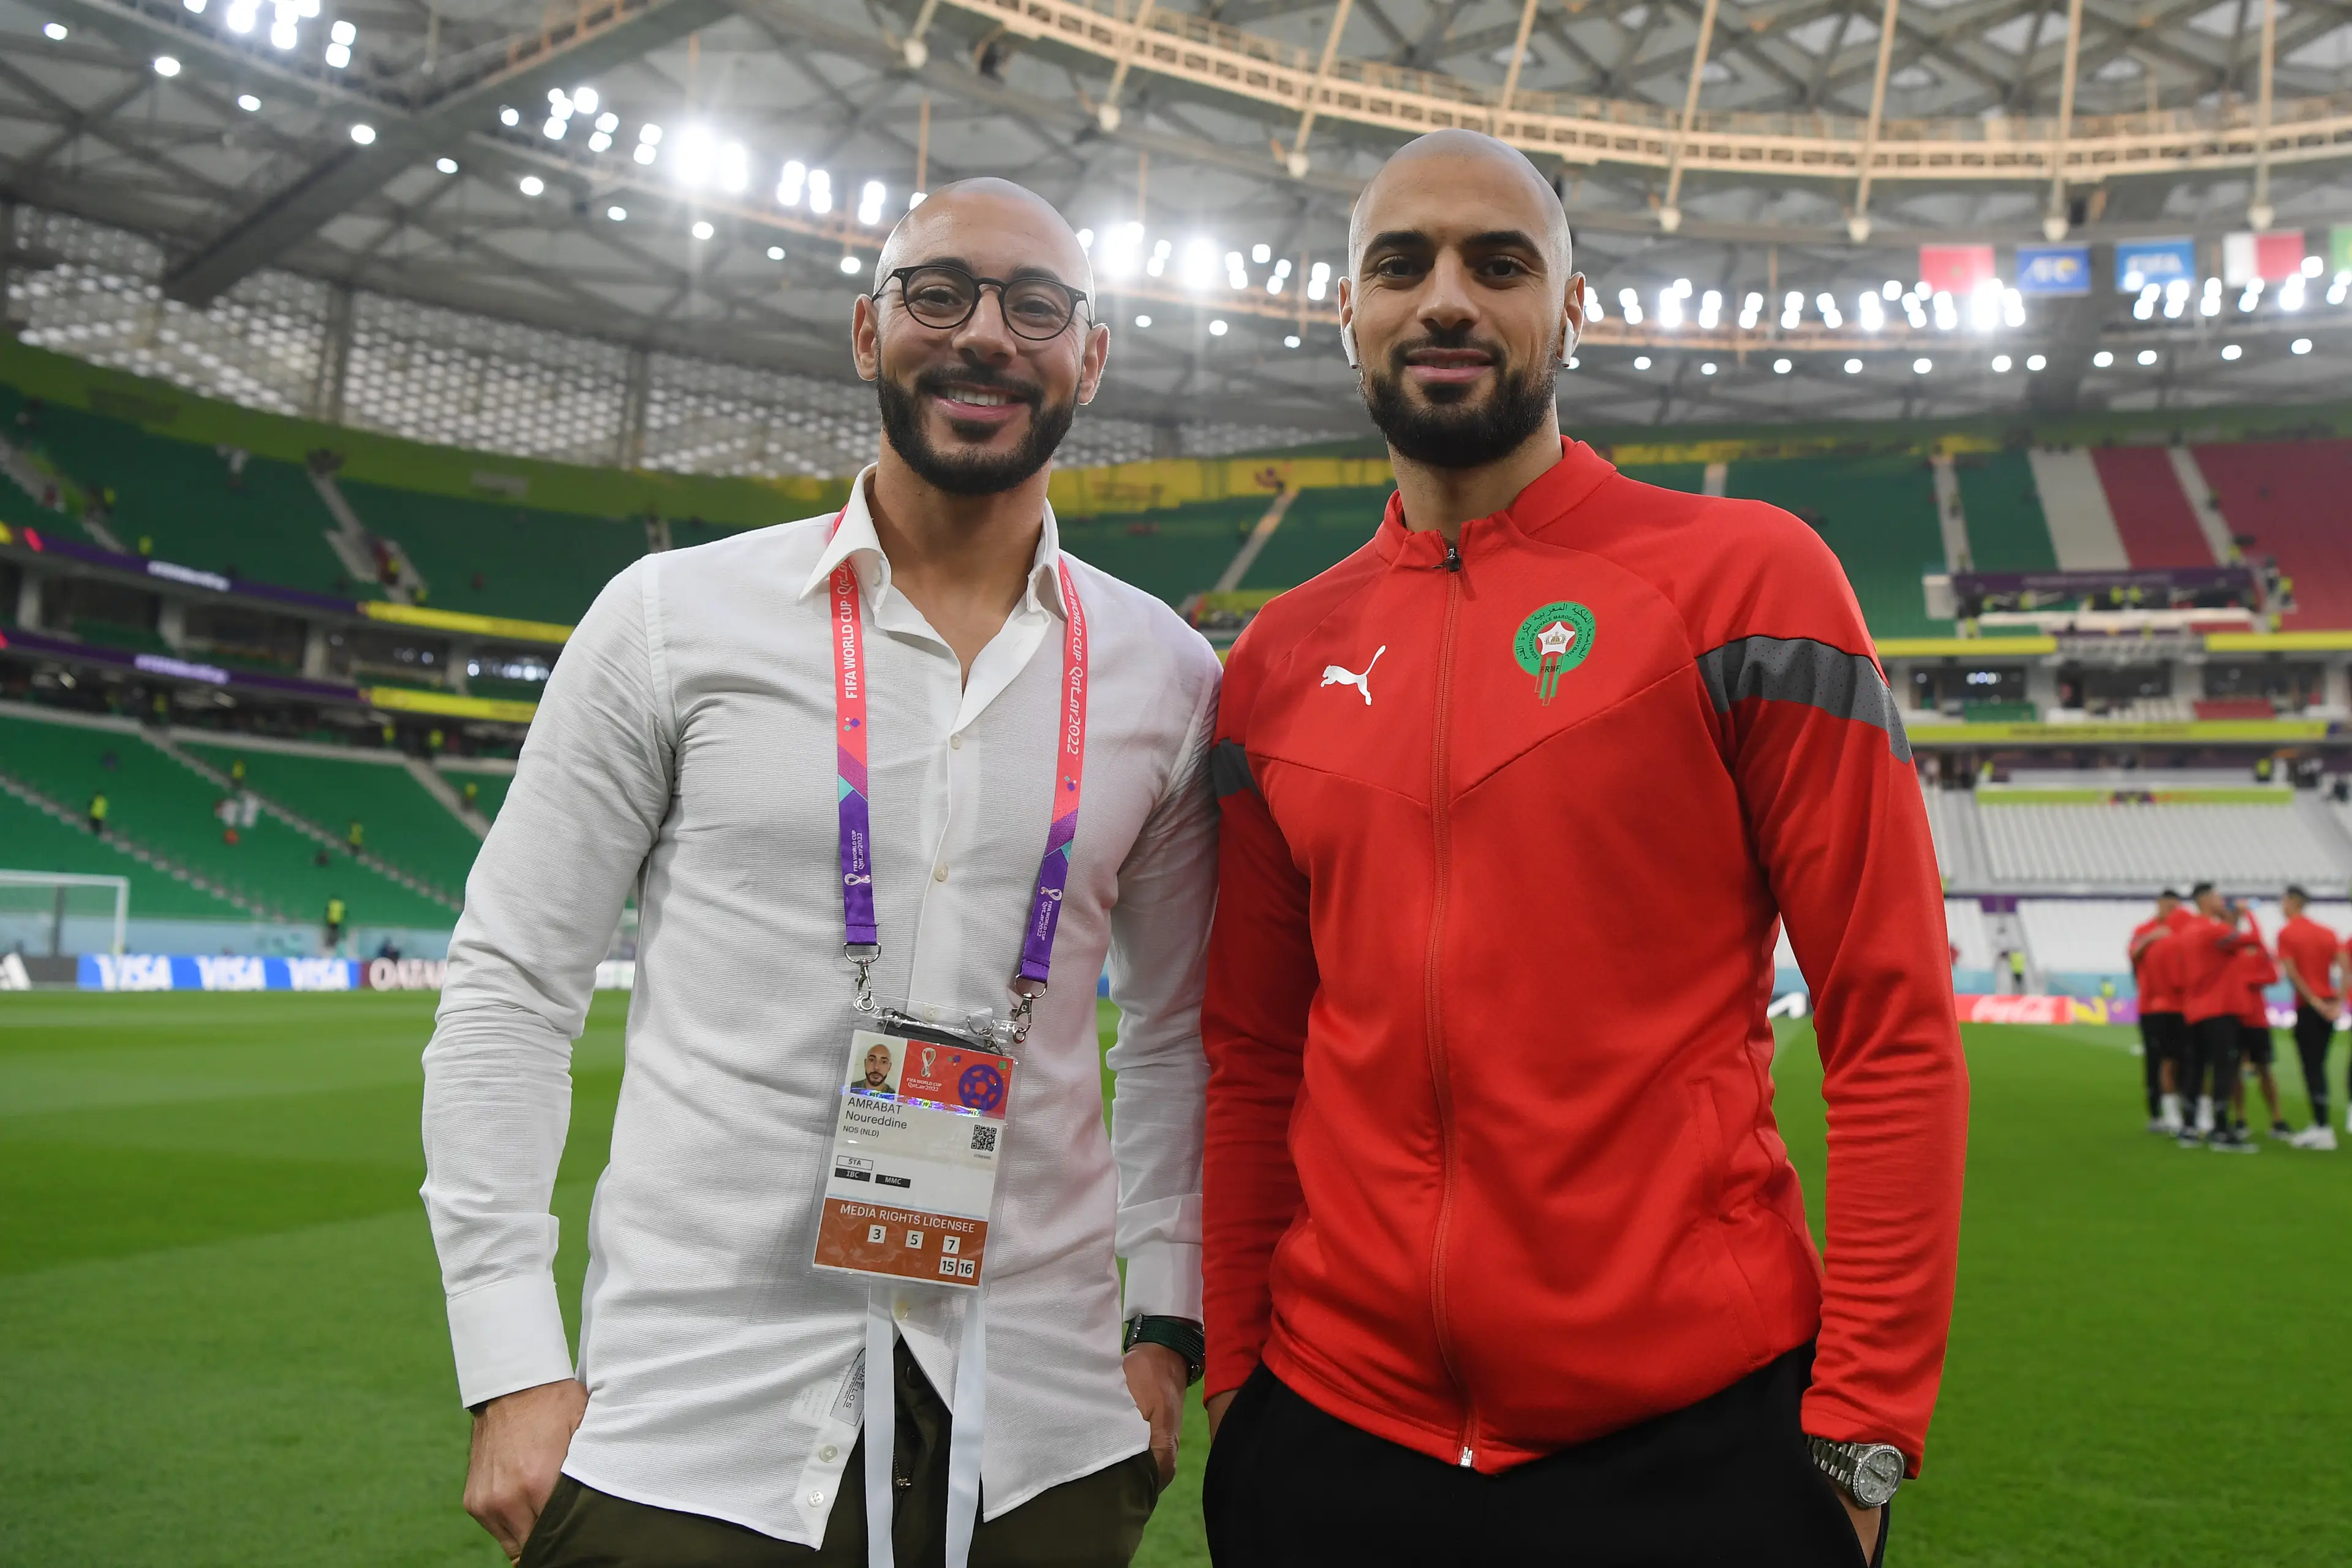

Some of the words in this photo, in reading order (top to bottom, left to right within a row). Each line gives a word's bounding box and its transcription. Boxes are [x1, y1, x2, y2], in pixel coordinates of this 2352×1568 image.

[1064, 574, 1074, 597] FIFA
[840, 600, 853, 623] CUP
[1069, 596, 1082, 636] WORLD
[1531, 603, 1567, 620] المغربية
[1553, 615, 1580, 627] MAROCAINE
[1572, 605, 1593, 625] الملكية
[1534, 617, 1551, 632] ROYALE
[842, 624, 856, 669] WORLD
[1072, 638, 1082, 662] CUP
[1565, 633, 1582, 657] FOOTBALL
[1578, 626, 1594, 659] الجامعة
[1540, 665, 1561, 673] FRMF
[845, 671, 858, 698] FIFA
[94, 954, 173, 991] VISA
[195, 955, 266, 991] VISA
[285, 957, 351, 991] VISA
[847, 1097, 902, 1114] AMRABAT
[845, 1110, 907, 1129] Noureddine
[860, 1128, 880, 1137] (NLD)
[840, 1204, 876, 1218] MEDIA
[880, 1209, 921, 1225] RIGHTS
[923, 1216, 975, 1233] LICENSEE
[873, 1229, 881, 1240] 3
[910, 1234, 919, 1245] 5
[948, 1240, 956, 1250] 7
[942, 1260, 954, 1272] 15
[960, 1263, 973, 1274] 16
[845, 1368, 865, 1409] OMELOS
